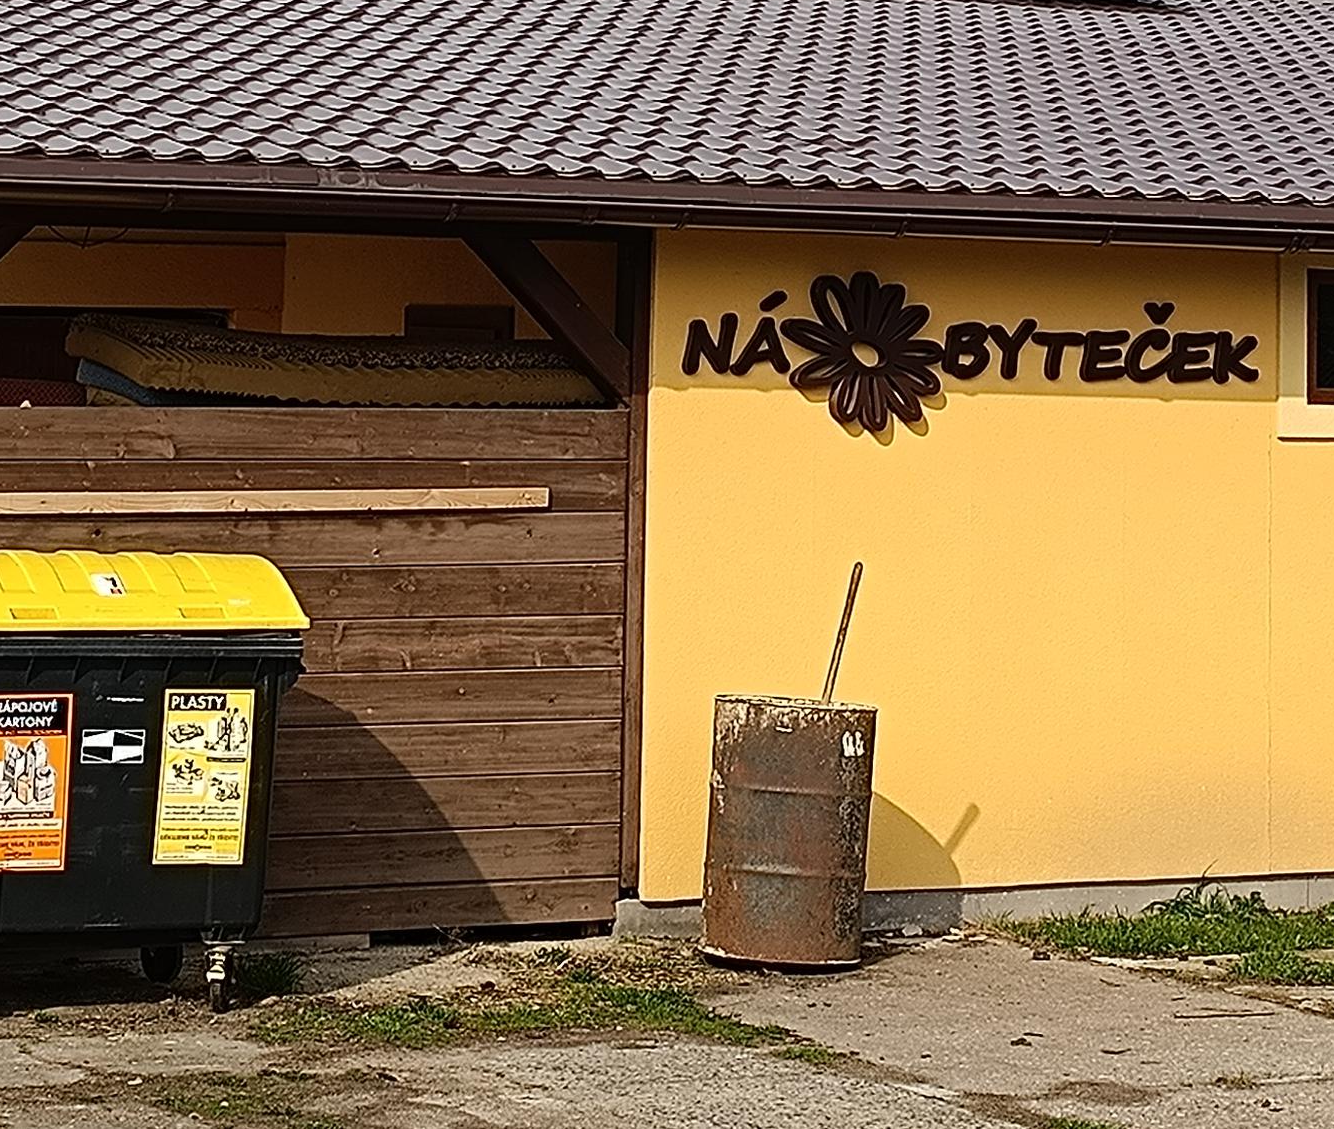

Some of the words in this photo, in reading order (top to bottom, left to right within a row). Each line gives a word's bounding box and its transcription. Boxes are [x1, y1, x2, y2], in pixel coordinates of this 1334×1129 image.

[682, 291, 791, 376] NÁ
[943, 302, 1261, 384] BYTEČEK
[171, 695, 225, 710] PLASTY
